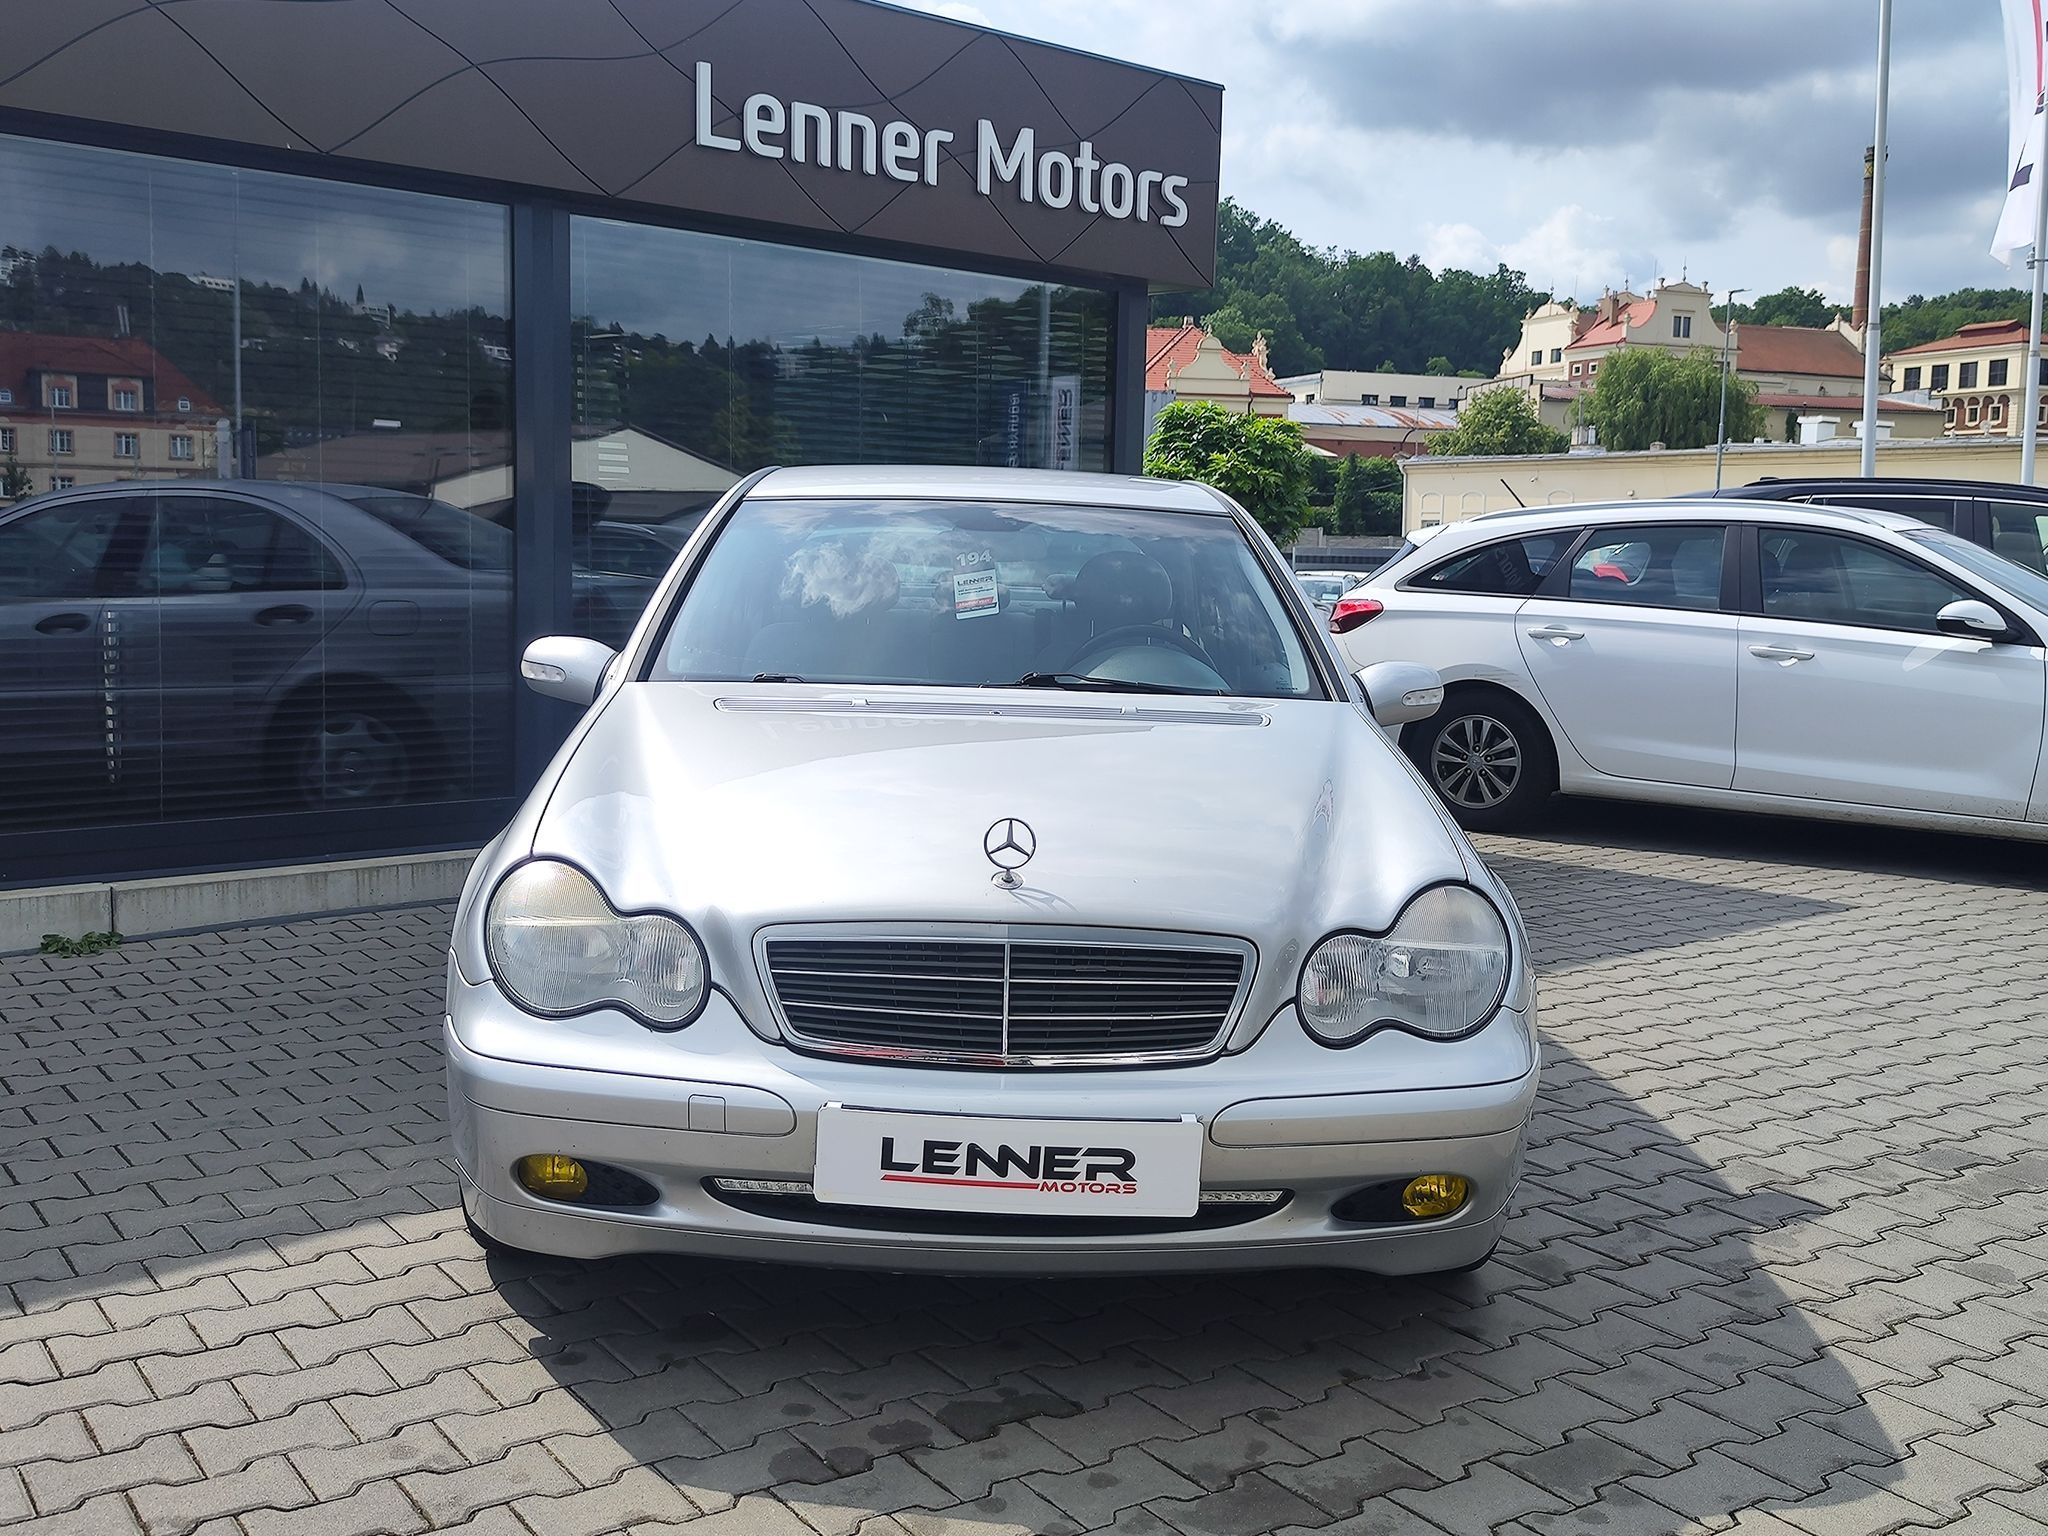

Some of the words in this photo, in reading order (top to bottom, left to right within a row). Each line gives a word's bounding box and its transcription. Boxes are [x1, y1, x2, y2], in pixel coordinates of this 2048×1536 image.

[695, 61, 954, 187] Lenner
[976, 118, 1189, 228] Motors
[956, 549, 992, 567] 194
[880, 1136, 1138, 1182] LENNER
[1039, 1181, 1138, 1194] MOTORS
